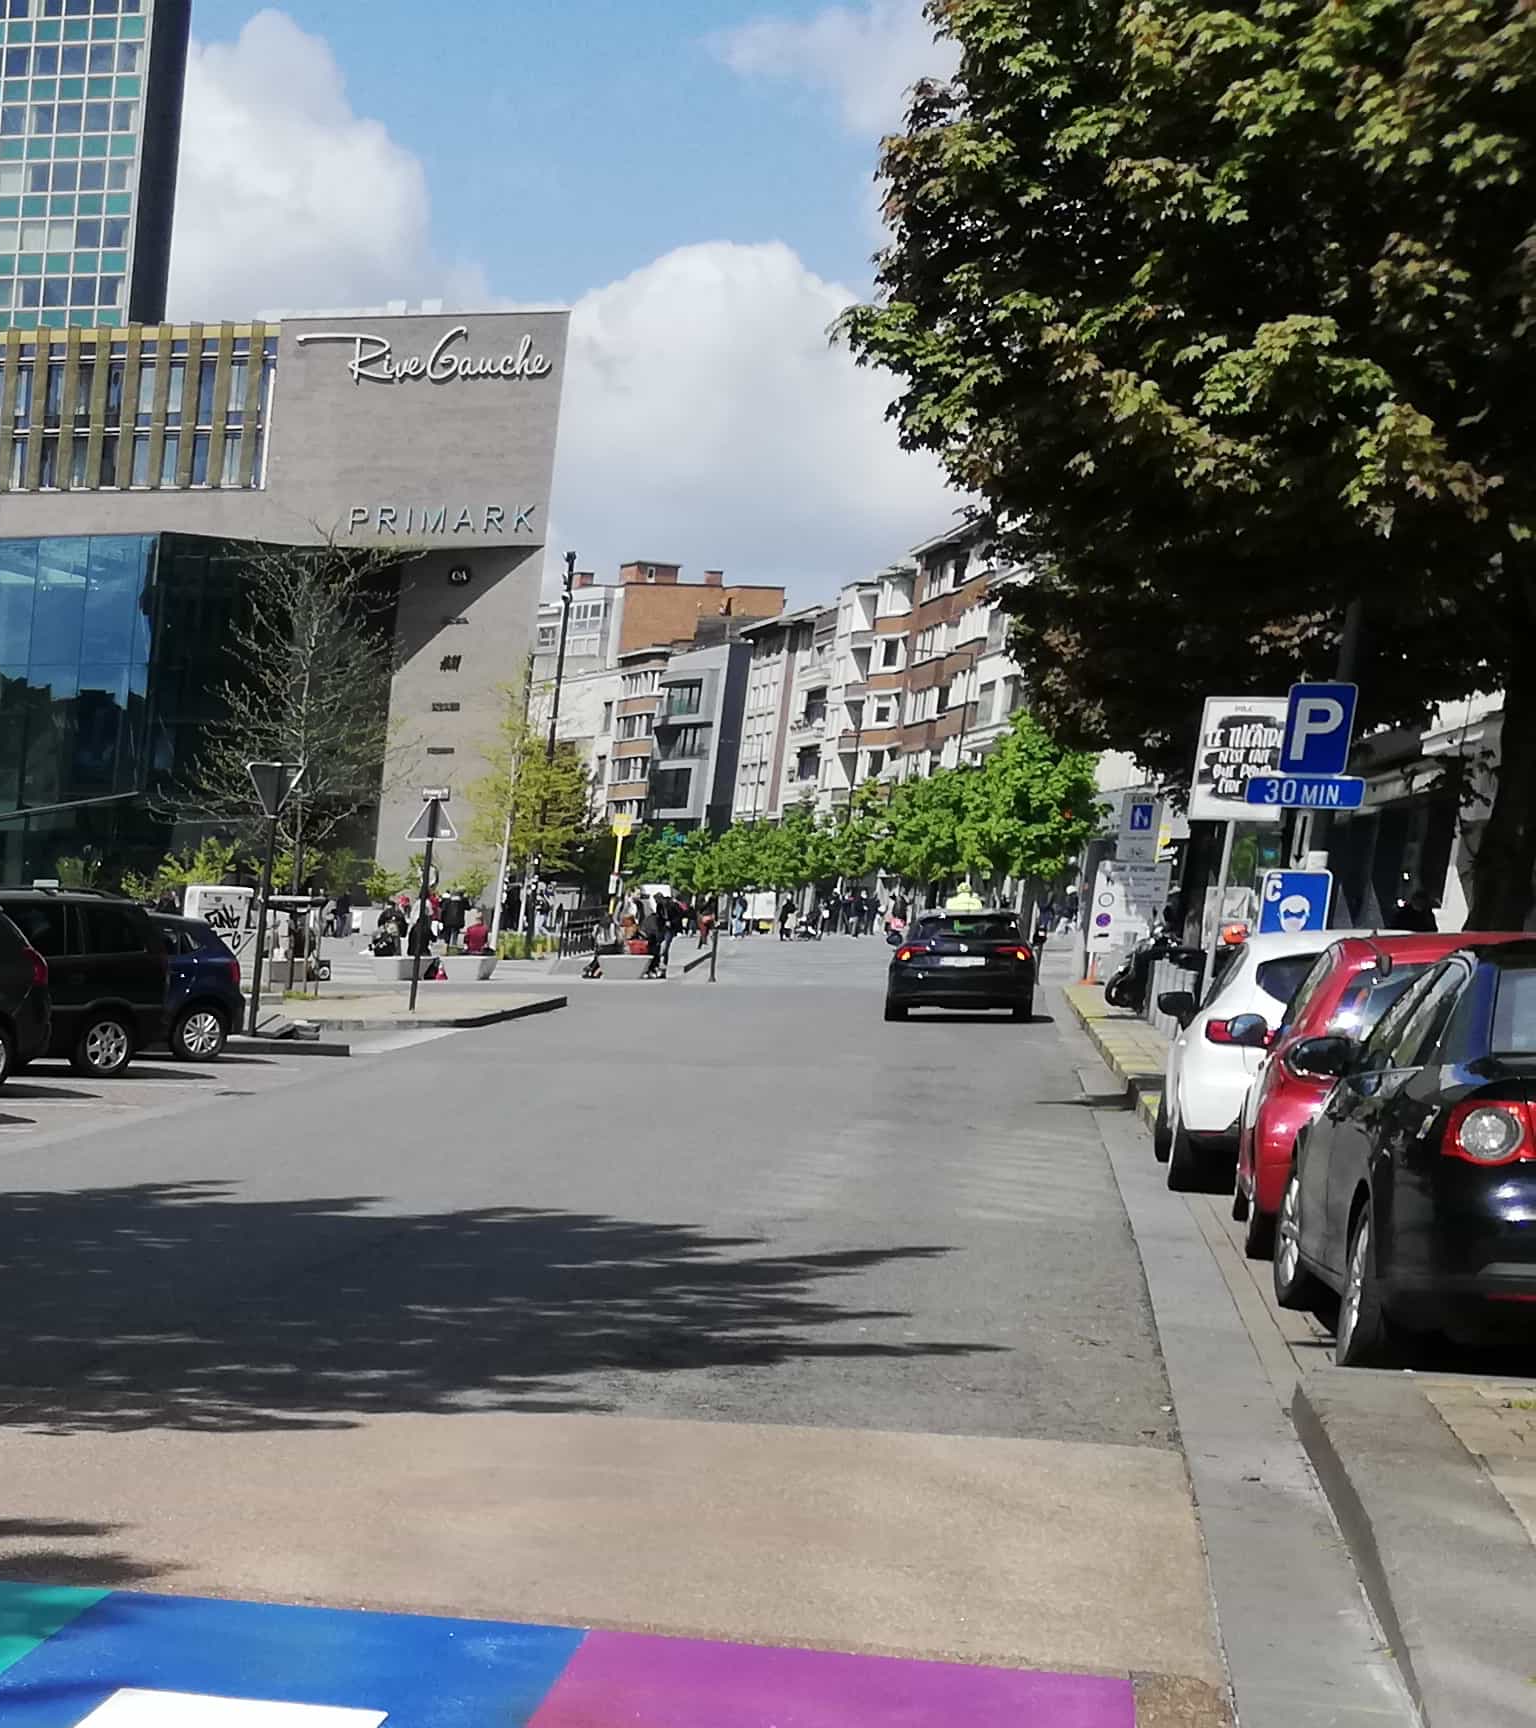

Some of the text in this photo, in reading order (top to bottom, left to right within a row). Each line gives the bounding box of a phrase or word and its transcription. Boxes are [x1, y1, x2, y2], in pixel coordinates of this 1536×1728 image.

[296, 326, 554, 386] Rive Gauche
[348, 504, 536, 536] PRIMARK
[1204, 728, 1226, 748] LE
[1289, 698, 1344, 761] P
[1264, 780, 1297, 804] 30
